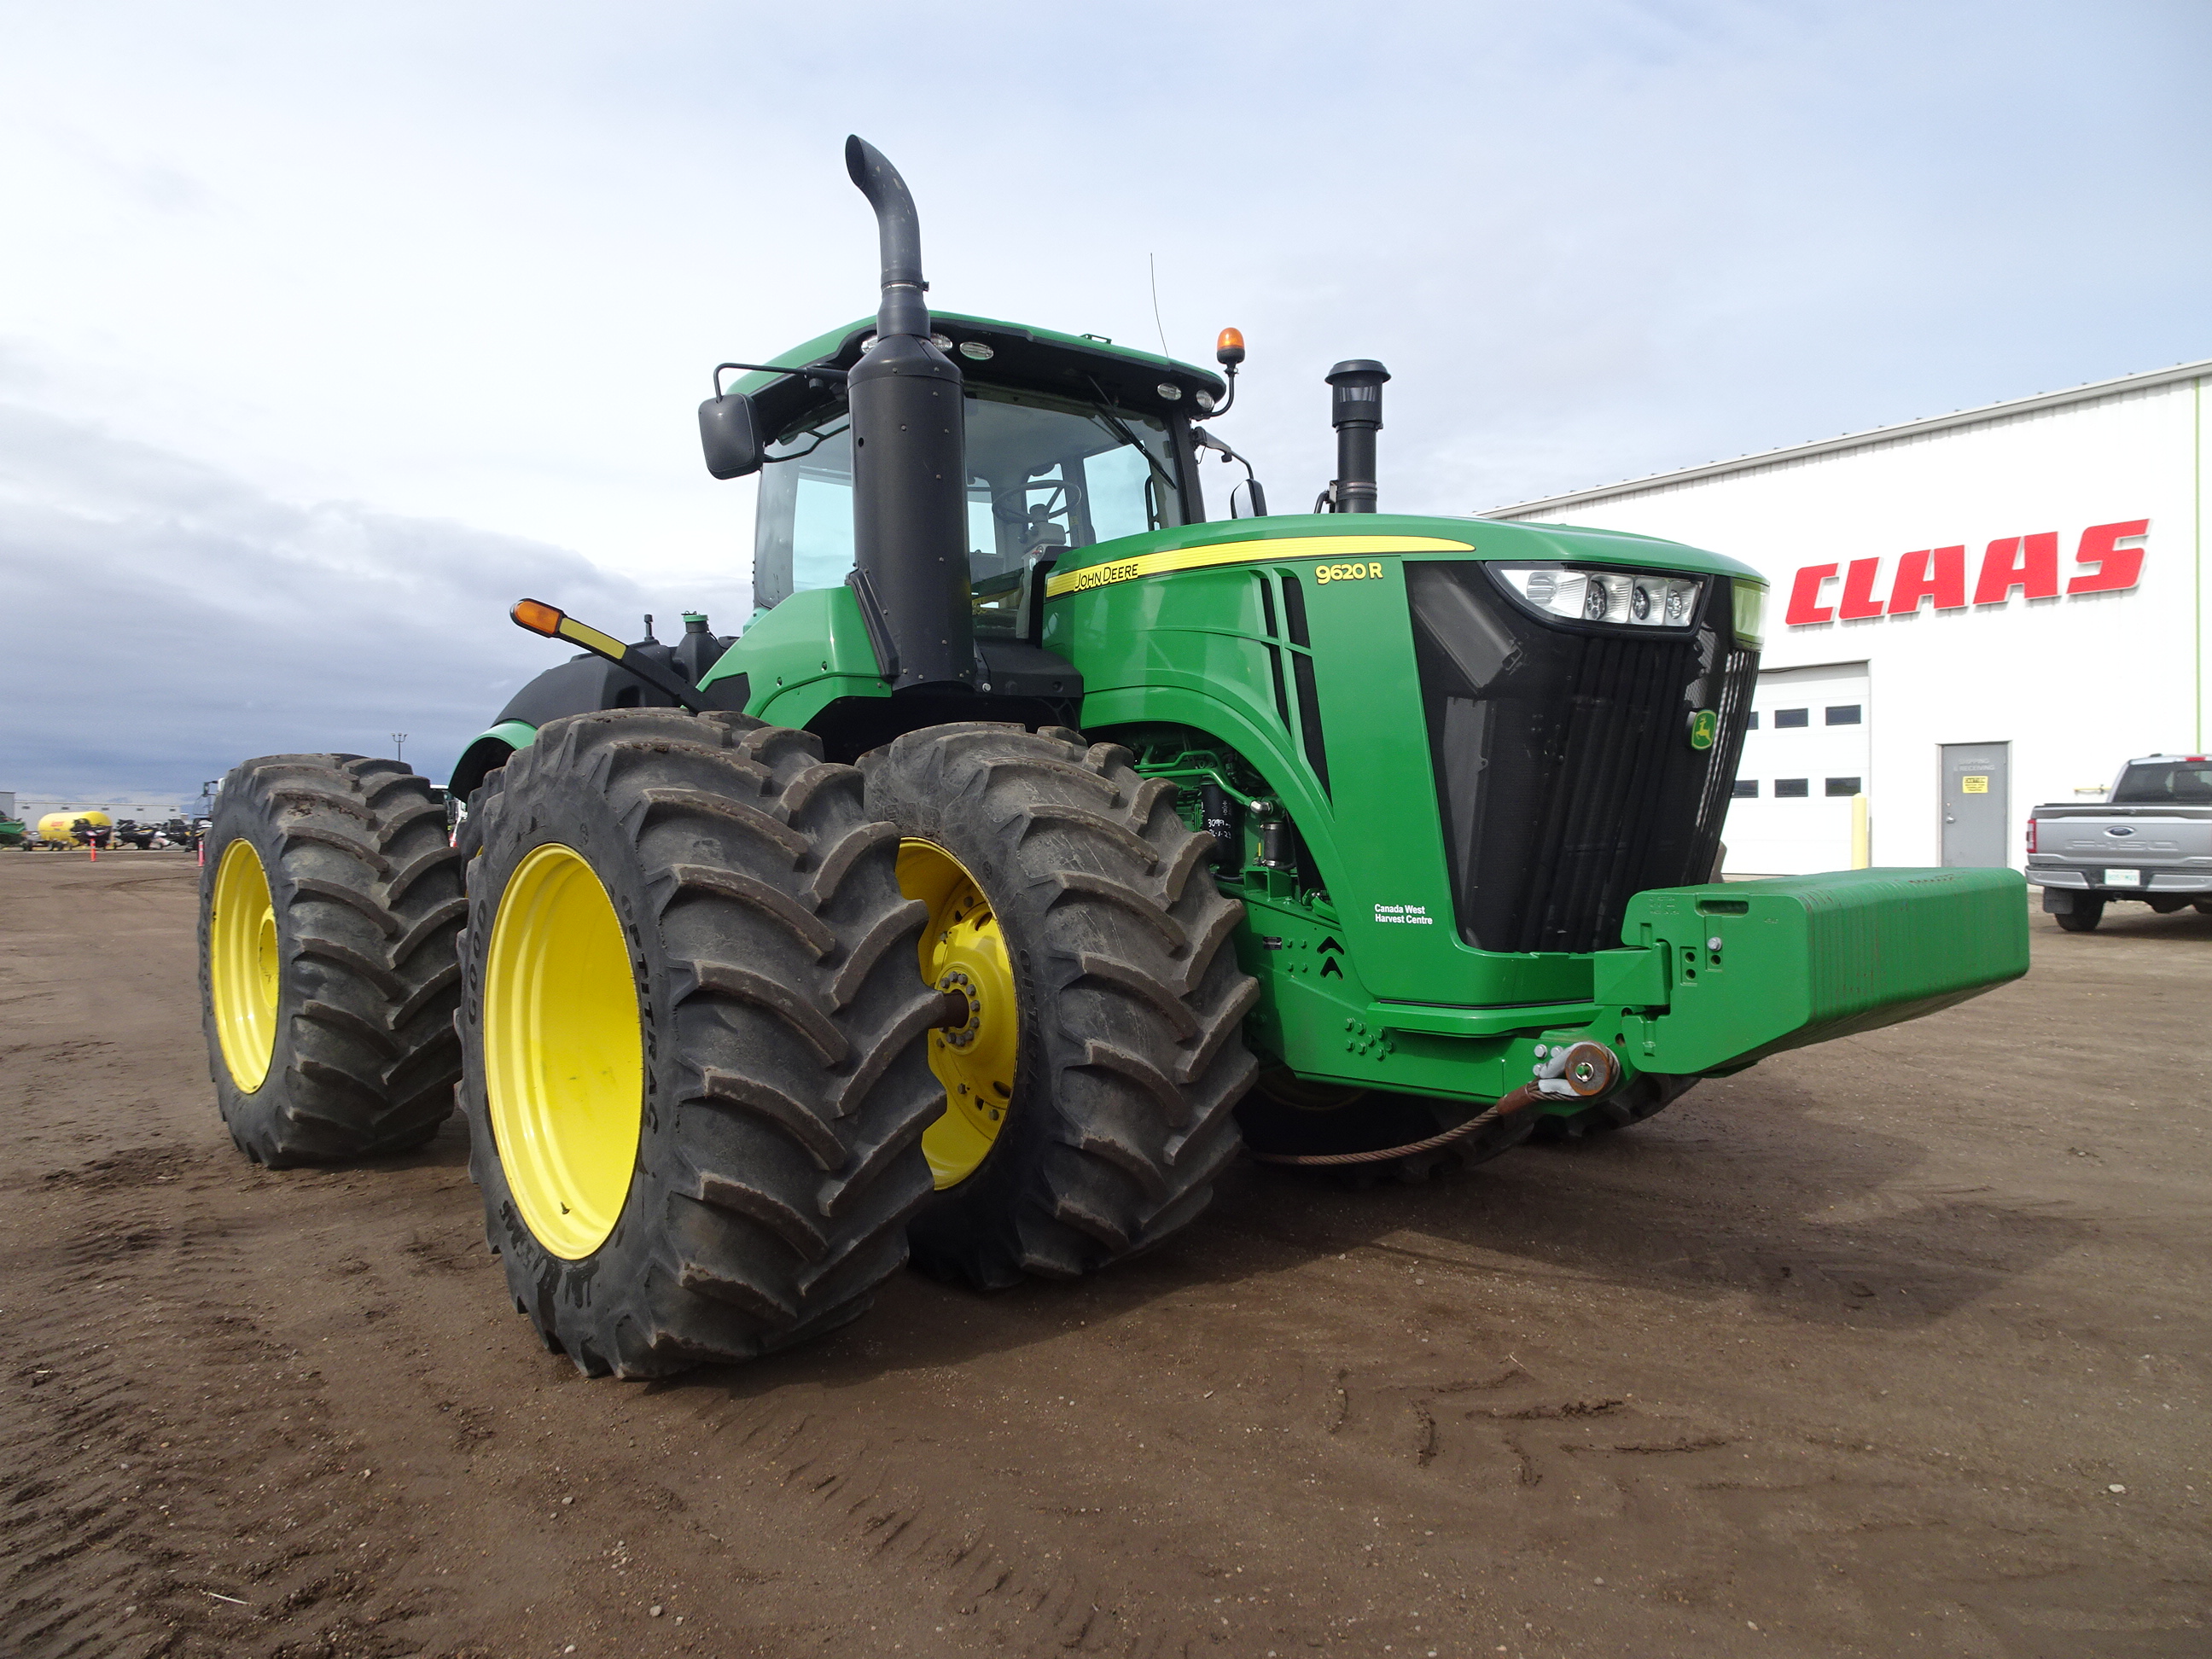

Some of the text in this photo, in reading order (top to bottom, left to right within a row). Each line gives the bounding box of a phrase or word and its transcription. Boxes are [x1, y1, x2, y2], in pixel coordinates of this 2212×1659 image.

[1074, 563, 1138, 591] JOHN DEERE
[1785, 517, 2151, 626] CLAAS
[2065, 839, 2179, 852] F-150
[1374, 903, 1426, 915] Canada West
[1375, 913, 1434, 925] Harvest Centre
